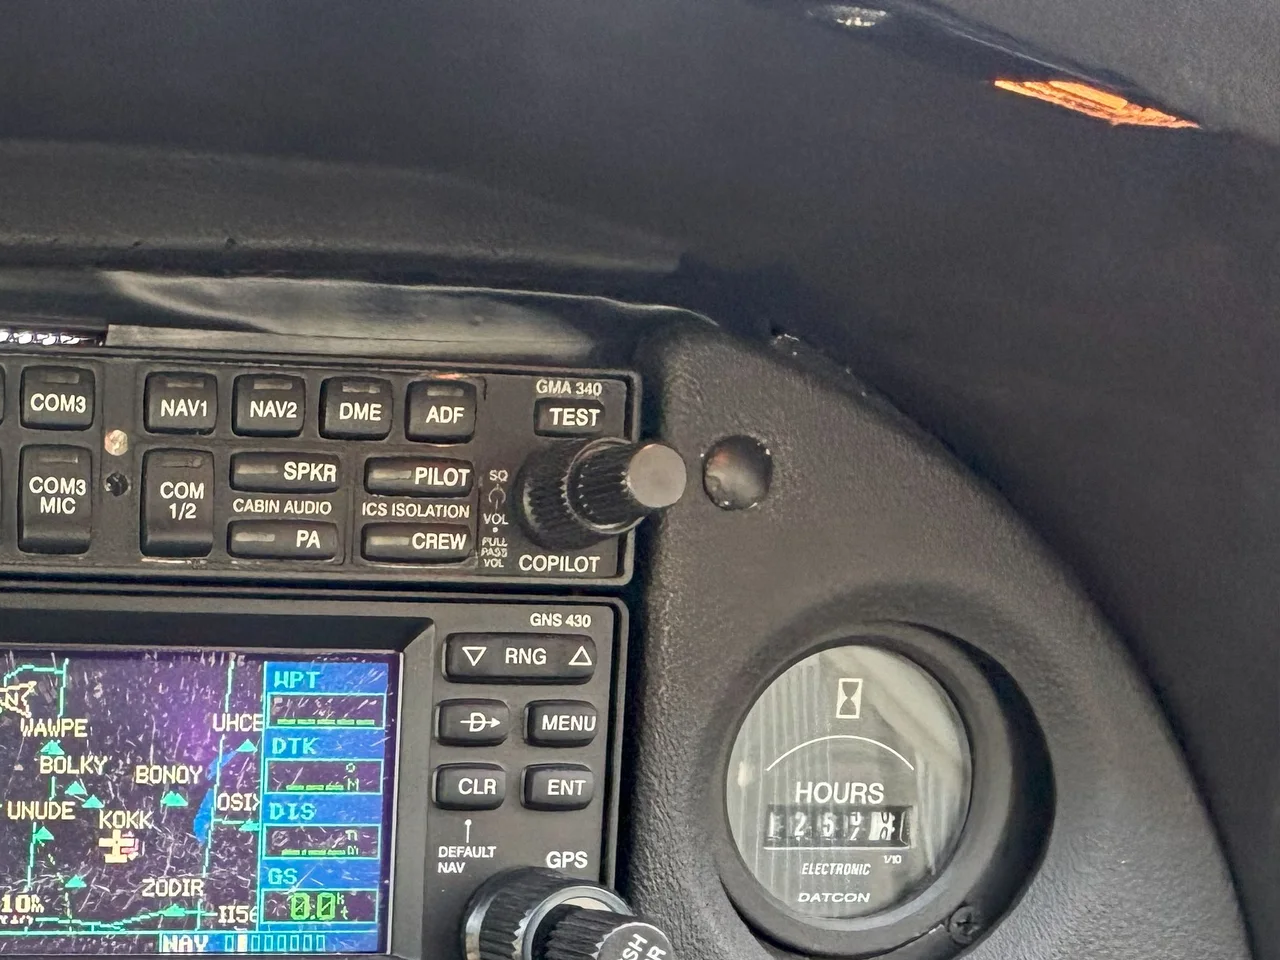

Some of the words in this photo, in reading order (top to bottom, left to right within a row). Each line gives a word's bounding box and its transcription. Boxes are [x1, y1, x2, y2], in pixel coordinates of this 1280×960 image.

[536, 379, 572, 395] GMA
[575, 381, 602, 397] 340
[30, 393, 86, 414] COM3
[160, 398, 208, 417] NAV1
[250, 400, 298, 419] NAV2
[339, 402, 382, 421] DME
[425, 405, 465, 424] ADF
[549, 407, 600, 427] TEST
[283, 461, 336, 482] SPKR
[414, 467, 470, 487] PILOT
[29, 476, 87, 496] COM3
[159, 481, 204, 500] COM
[233, 498, 280, 514] CABIN
[284, 500, 332, 516] AUDIO
[362, 503, 387, 517] ICS
[391, 503, 469, 518] ISOLATION
[296, 530, 320, 549] PA
[412, 533, 467, 550] CREW
[519, 554, 600, 573] COPILOT
[530, 613, 562, 627] GNS
[565, 614, 591, 628] 430
[505, 648, 547, 665] RNG
[274, 671, 320, 689] WPT
[542, 715, 596, 732] MENU
[272, 737, 319, 755] DTK
[40, 756, 107, 775] BOLKY
[458, 778, 497, 795] CLR
[547, 779, 586, 795] ENT
[795, 782, 885, 805] HOURS
[8, 801, 75, 821] UNUDE
[99, 810, 152, 829] KOKK
[269, 803, 316, 820] DIS
[438, 846, 496, 858] DEFAULT
[546, 851, 588, 869] GPS
[267, 868, 298, 885] GS
[438, 862, 465, 873] NAV
[801, 863, 871, 876] ELECTRONIC
[797, 892, 871, 903] DATCON
[162, 935, 209, 952] NAV
